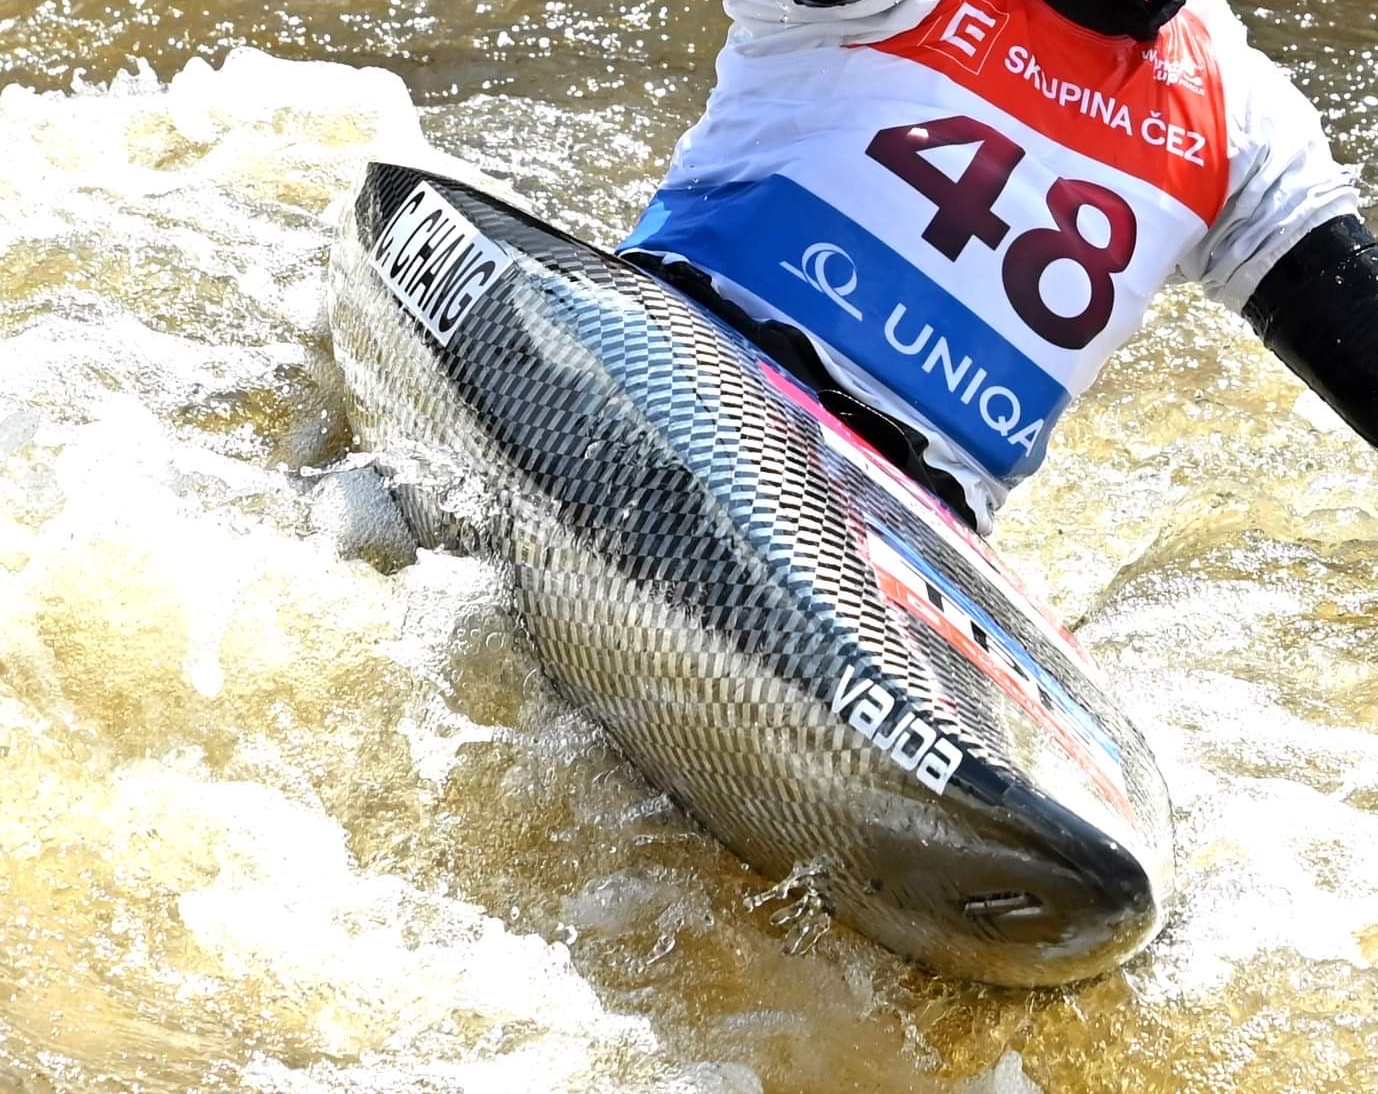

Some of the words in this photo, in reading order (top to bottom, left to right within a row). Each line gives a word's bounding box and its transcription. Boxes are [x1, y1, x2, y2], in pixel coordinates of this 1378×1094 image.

[1004, 46, 1133, 137] SKUPINA
[1141, 110, 1206, 167] ČEZ
[865, 115, 1137, 350] 48
[884, 302, 1045, 458] UNIQA
